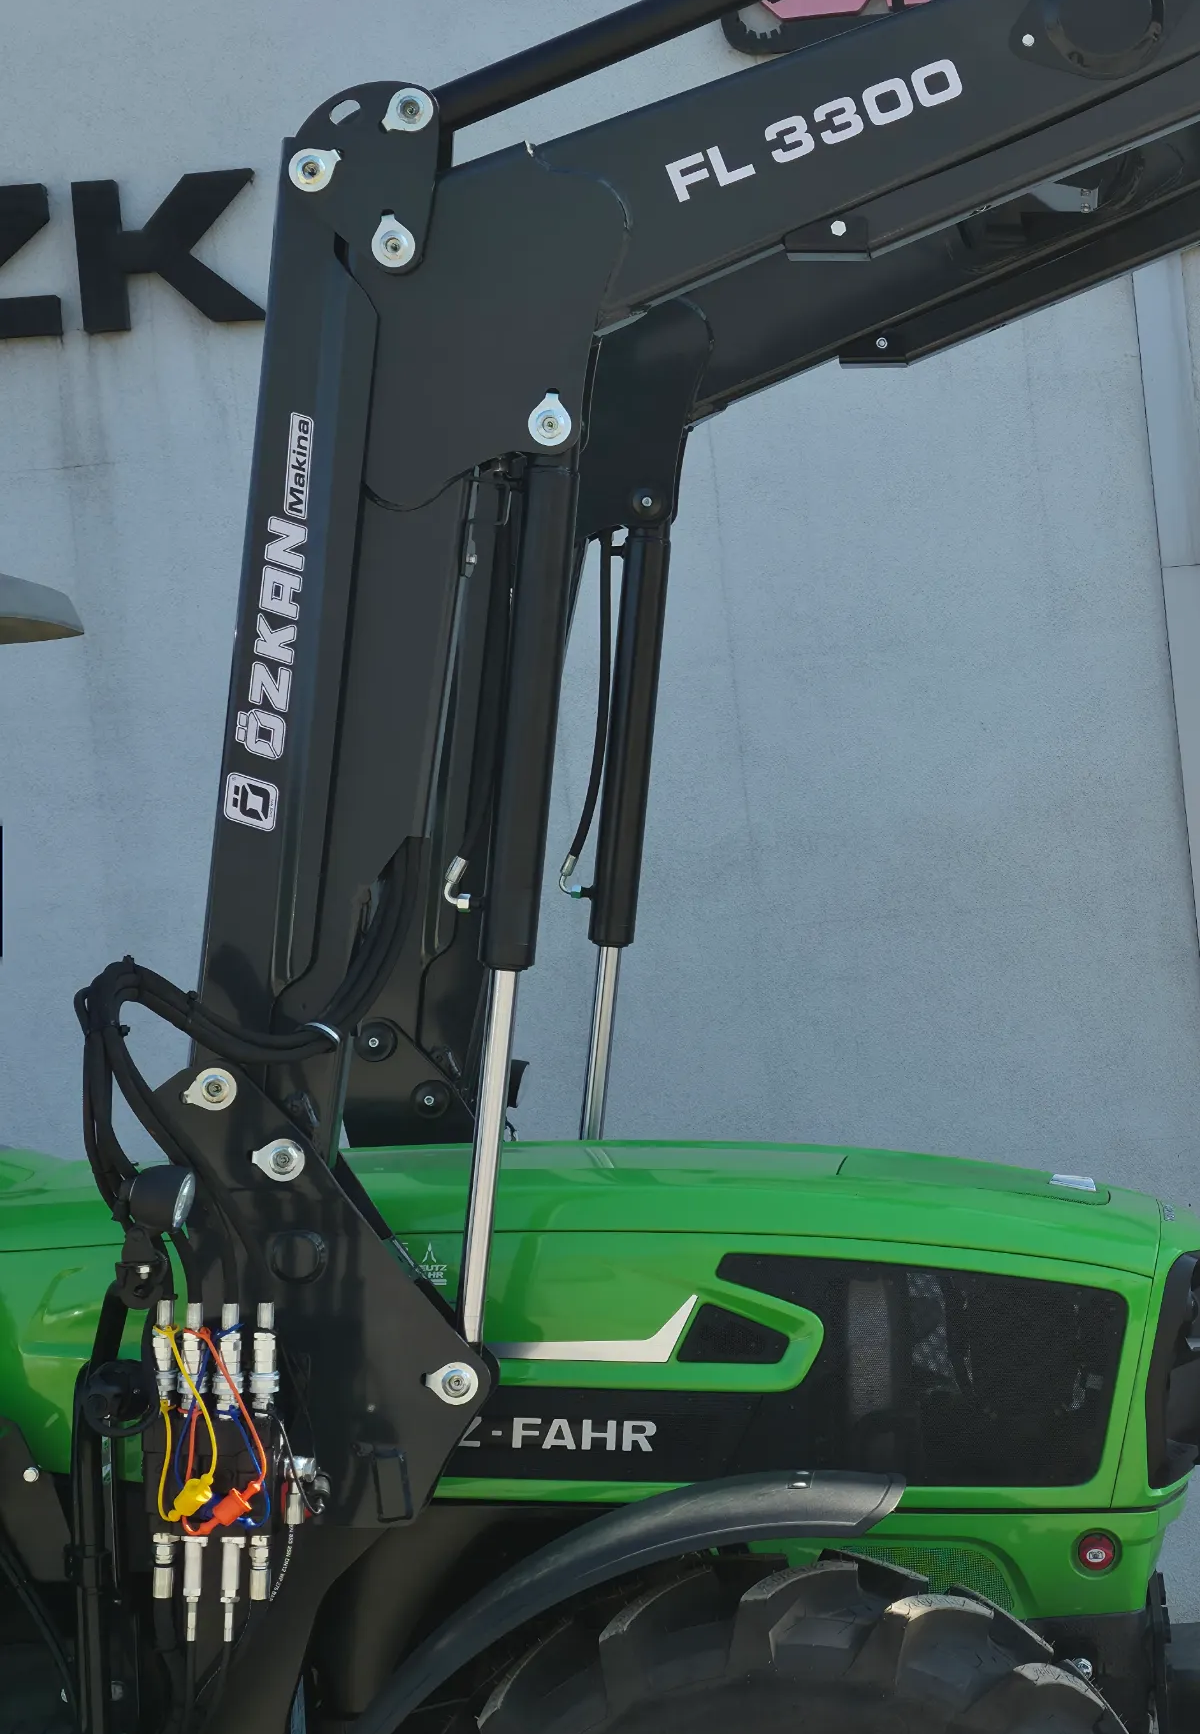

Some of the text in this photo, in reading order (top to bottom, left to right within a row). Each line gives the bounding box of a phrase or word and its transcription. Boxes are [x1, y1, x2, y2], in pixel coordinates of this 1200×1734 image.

[665, 59, 963, 203] FL 3300
[235, 516, 308, 760] ÖZKAN
[288, 419, 310, 514] Makina
[281, 1557, 290, 1573] DN12
